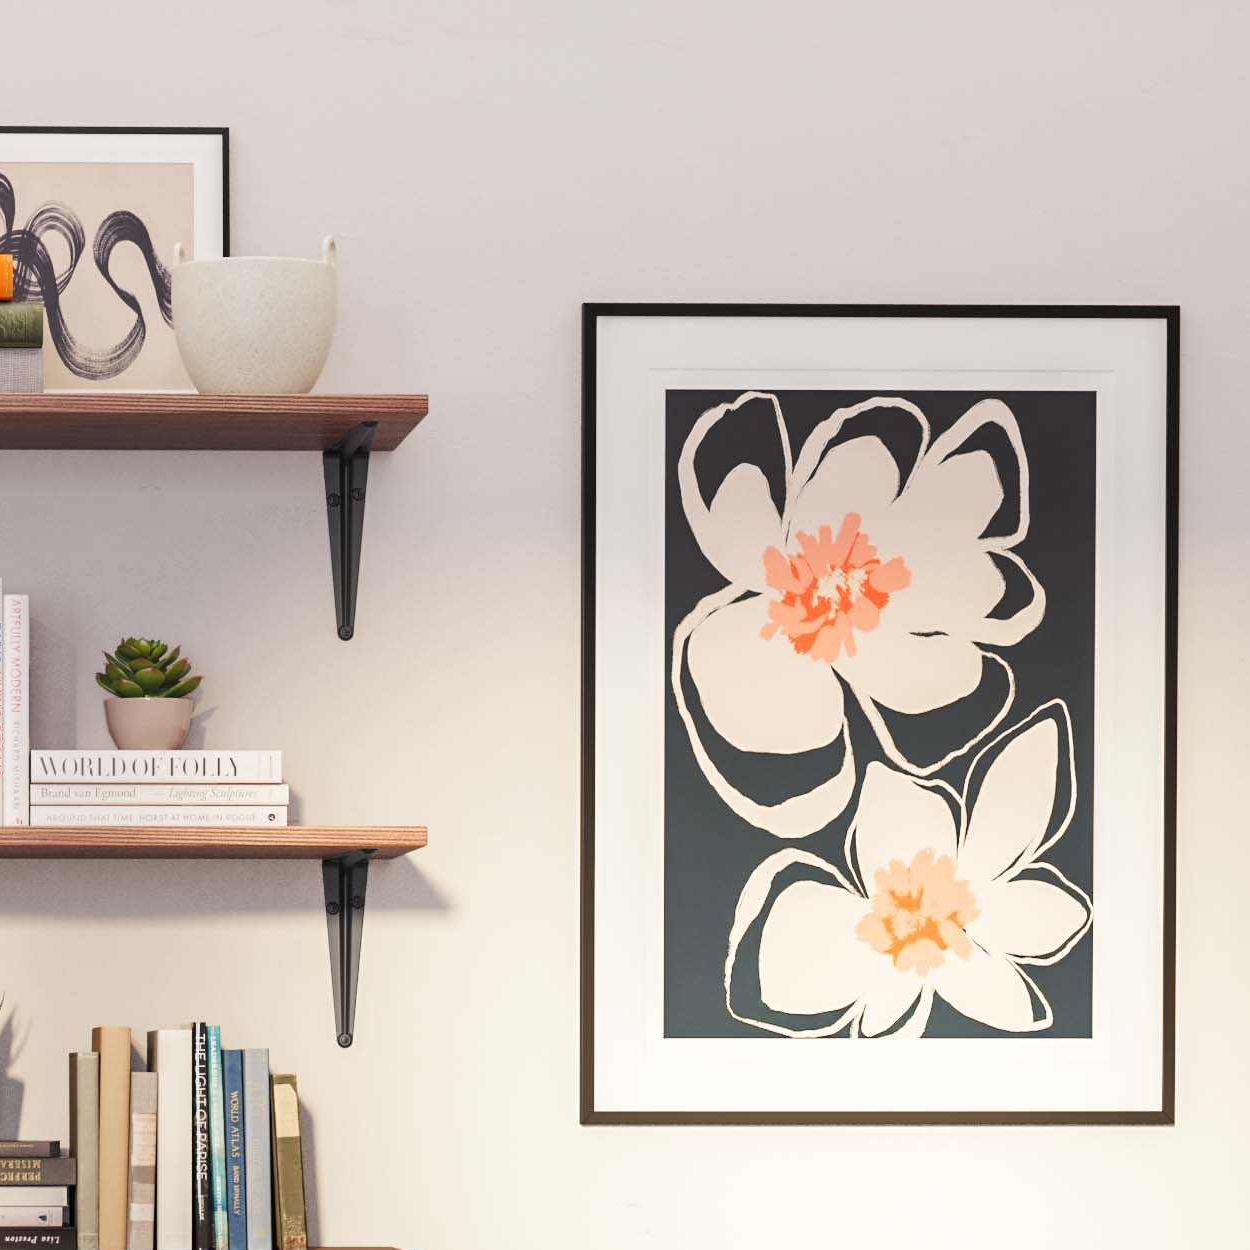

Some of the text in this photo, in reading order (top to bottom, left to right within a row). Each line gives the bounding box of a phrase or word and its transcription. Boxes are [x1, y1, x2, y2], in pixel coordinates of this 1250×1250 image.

[10, 599, 22, 713] ARTFULLY MODERN
[39, 756, 239, 777] WORLD OF FOLLY
[40, 786, 136, 801] Brand van Egmond
[168, 786, 258, 801] Lighting Sculptures
[195, 1033, 206, 1061] THE
[195, 1064, 206, 1106] LIGHT
[195, 1108, 207, 1129] OF
[230, 1090, 240, 1158] WORLD ATLAS
[4, 1235, 60, 1245] Lisa Preston
